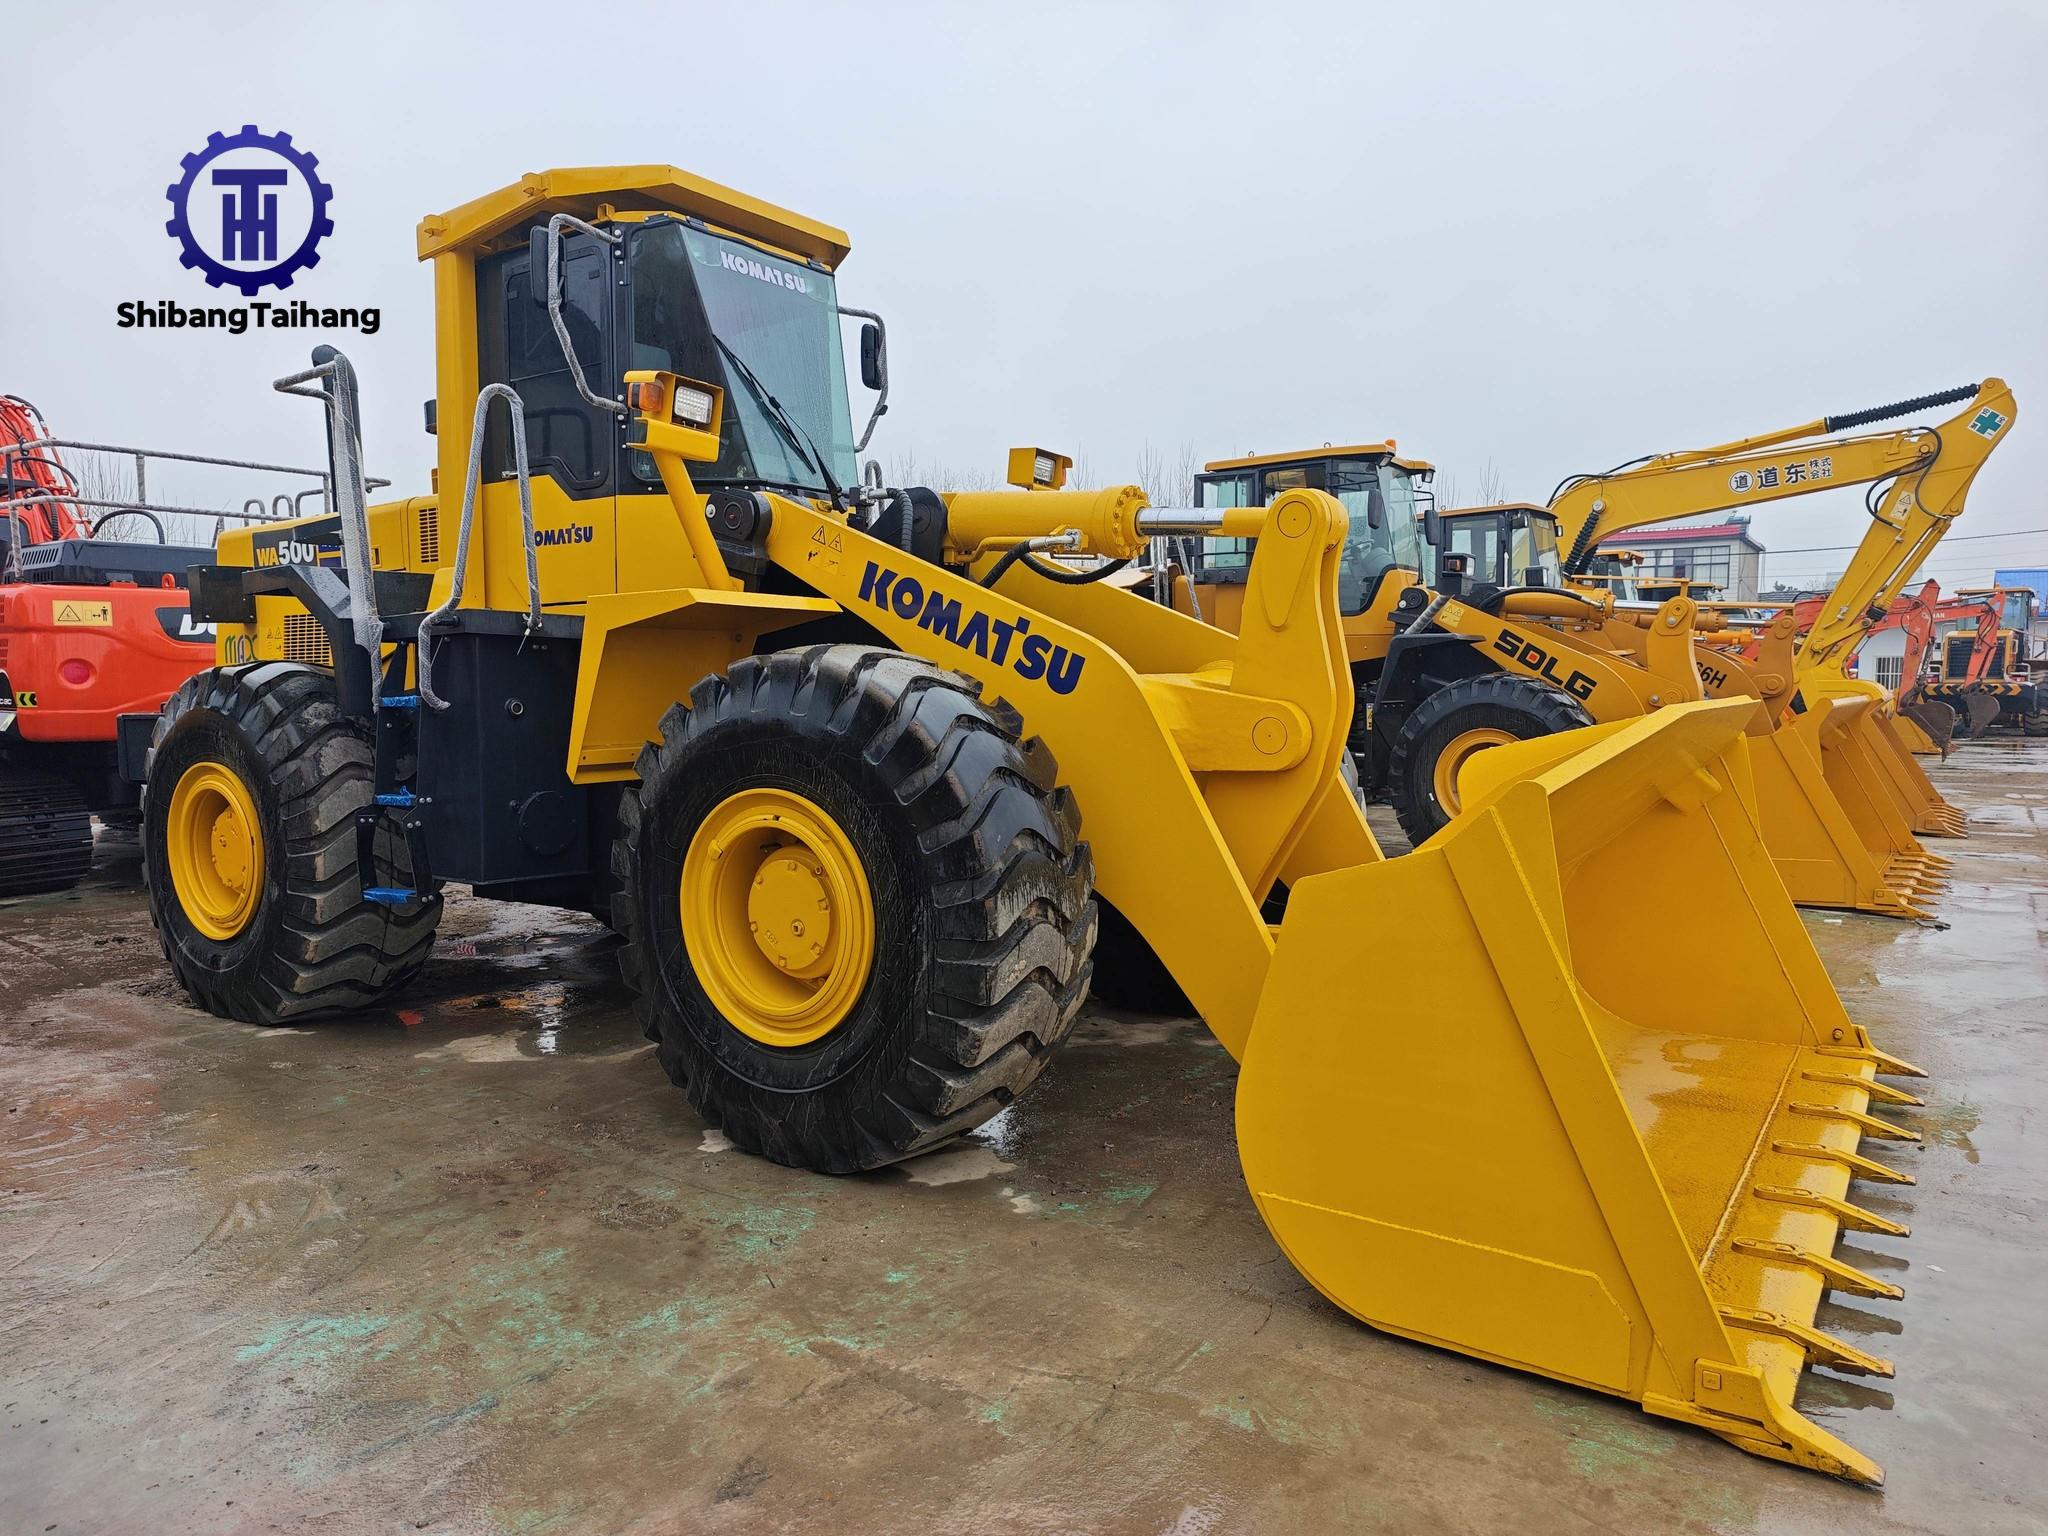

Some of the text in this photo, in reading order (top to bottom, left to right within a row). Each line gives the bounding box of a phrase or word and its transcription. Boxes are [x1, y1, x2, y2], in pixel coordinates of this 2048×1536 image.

[720, 251, 806, 294] KOMATSU
[1757, 466, 1807, 489] 道东
[523, 523, 593, 547] OMATSU
[858, 560, 1086, 695] KOMATSU
[1493, 628, 1598, 700] SDLG
